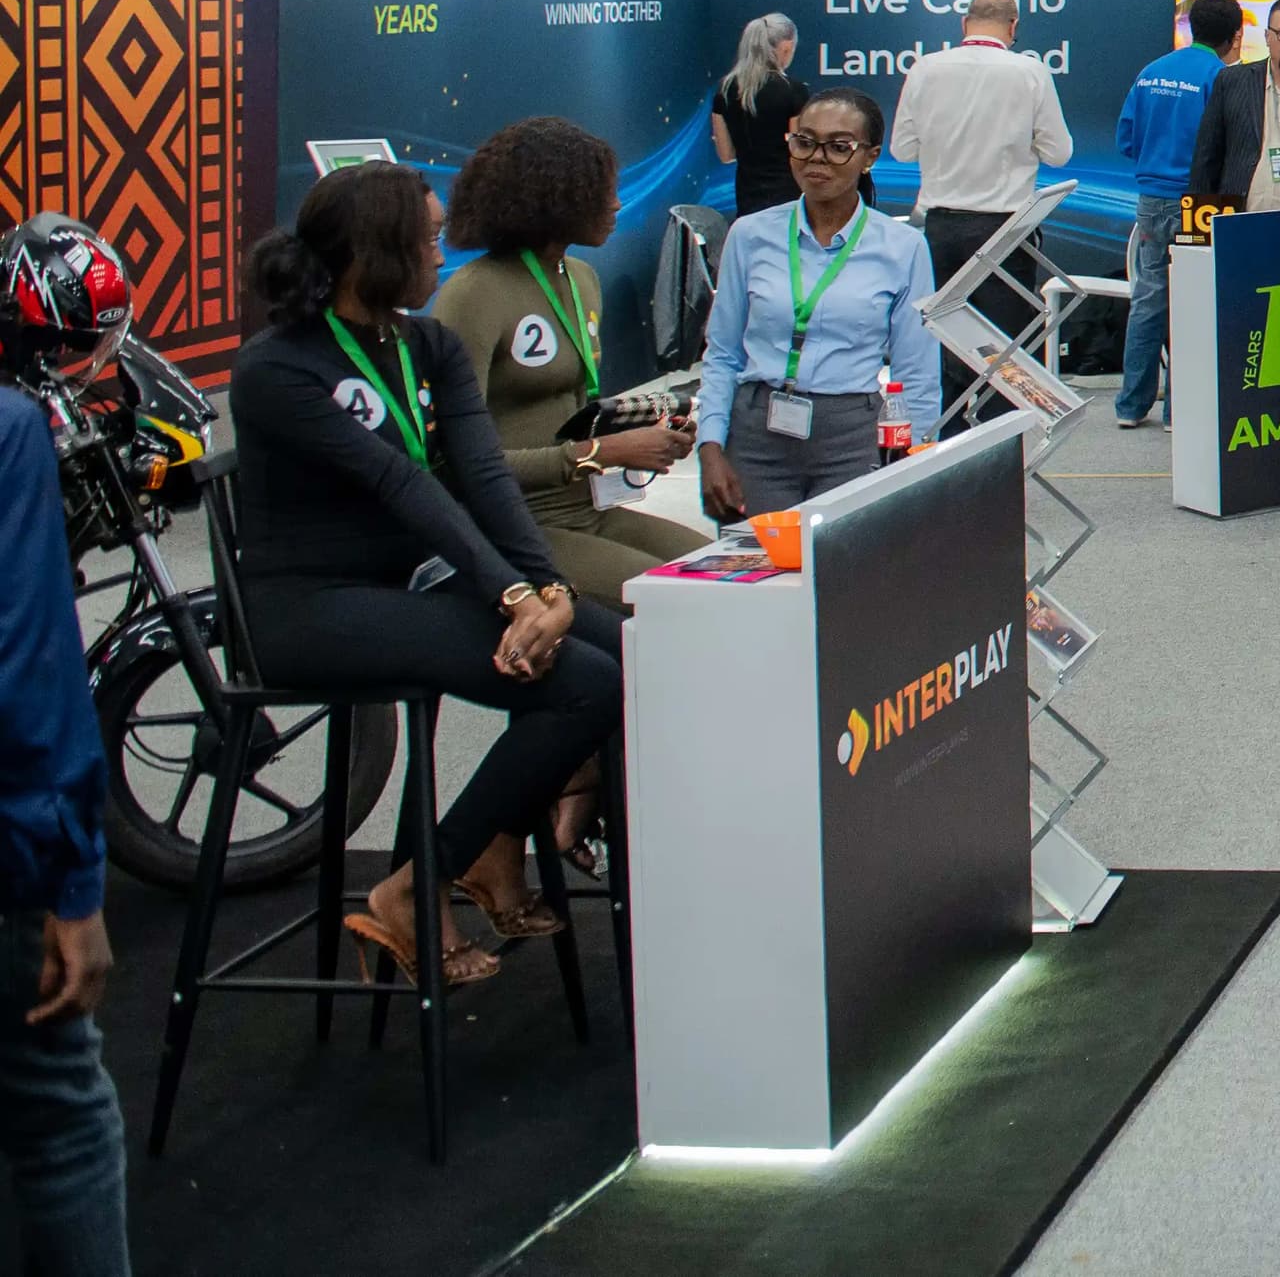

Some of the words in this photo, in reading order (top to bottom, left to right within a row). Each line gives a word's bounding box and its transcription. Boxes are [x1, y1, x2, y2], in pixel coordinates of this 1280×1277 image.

[374, 3, 439, 35] YEARS
[544, 2, 601, 26] WINNING
[602, 0, 662, 23] TOGETHER
[522, 323, 548, 359] 2
[1242, 329, 1263, 391] YEARS
[347, 388, 374, 423] 4
[873, 622, 1012, 752] INTERPLAY
